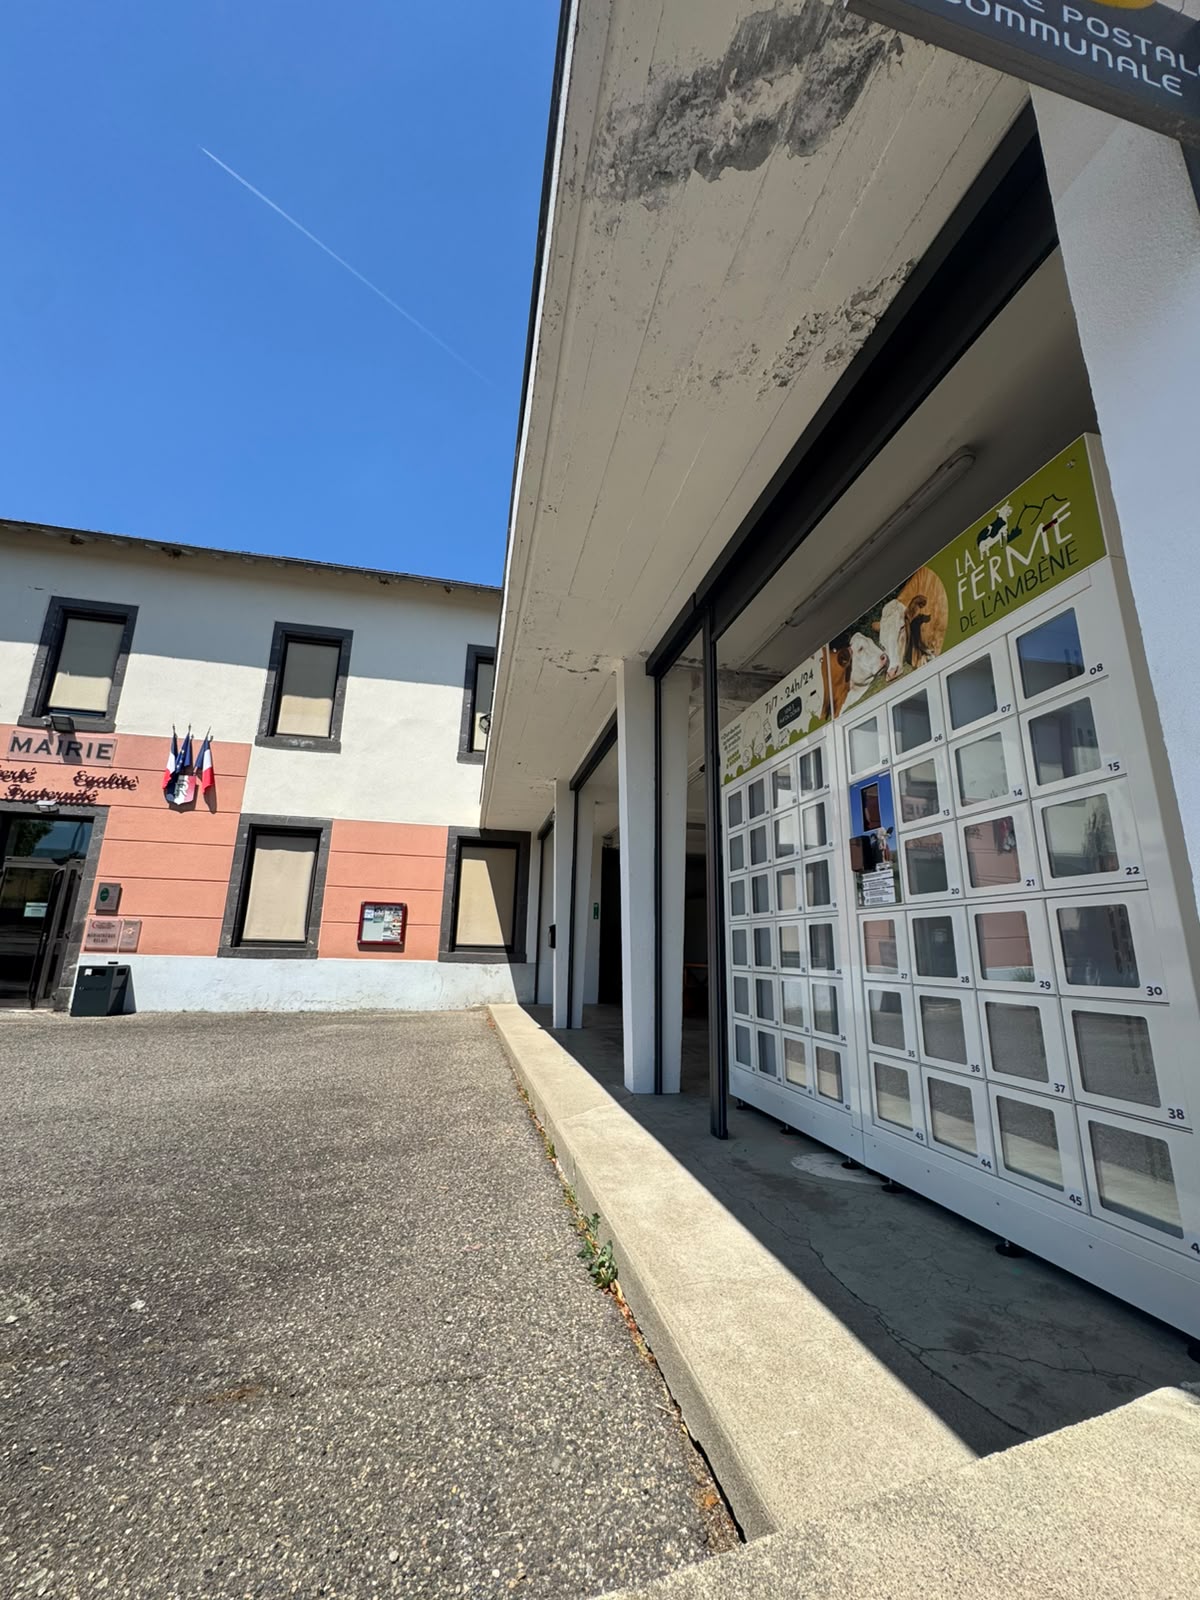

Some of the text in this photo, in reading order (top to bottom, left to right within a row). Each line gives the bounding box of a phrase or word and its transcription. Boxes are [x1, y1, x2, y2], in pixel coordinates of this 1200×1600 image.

[1063, 4, 1200, 77] POSTAL
[945, 0, 1183, 97] OMMUNALE
[957, 502, 1072, 612] FERME
[956, 548, 976, 578] LA
[960, 540, 1080, 633] DE L'AMBÈNE
[1088, 663, 1105, 677] 08
[785, 668, 814, 698] 24h/24
[1000, 704, 1012, 714] 07
[933, 733, 943, 743] 06
[10, 736, 114, 760] MAIRIE
[1107, 761, 1120, 772] 15
[1012, 788, 1023, 797] 14
[1125, 866, 1140, 876] 22
[1026, 878, 1036, 888] 21
[960, 975, 970, 984] 28
[1039, 980, 1051, 990] 29
[1146, 985, 1163, 996] 30
[970, 1064, 981, 1073] 36
[1053, 1083, 1066, 1094] 37
[1167, 1107, 1185, 1120] 38
[915, 1131, 924, 1141] 43
[980, 1158, 992, 1169] 44
[1068, 1193, 1082, 1206] 45
[1190, 1242, 1200, 1255] 4
